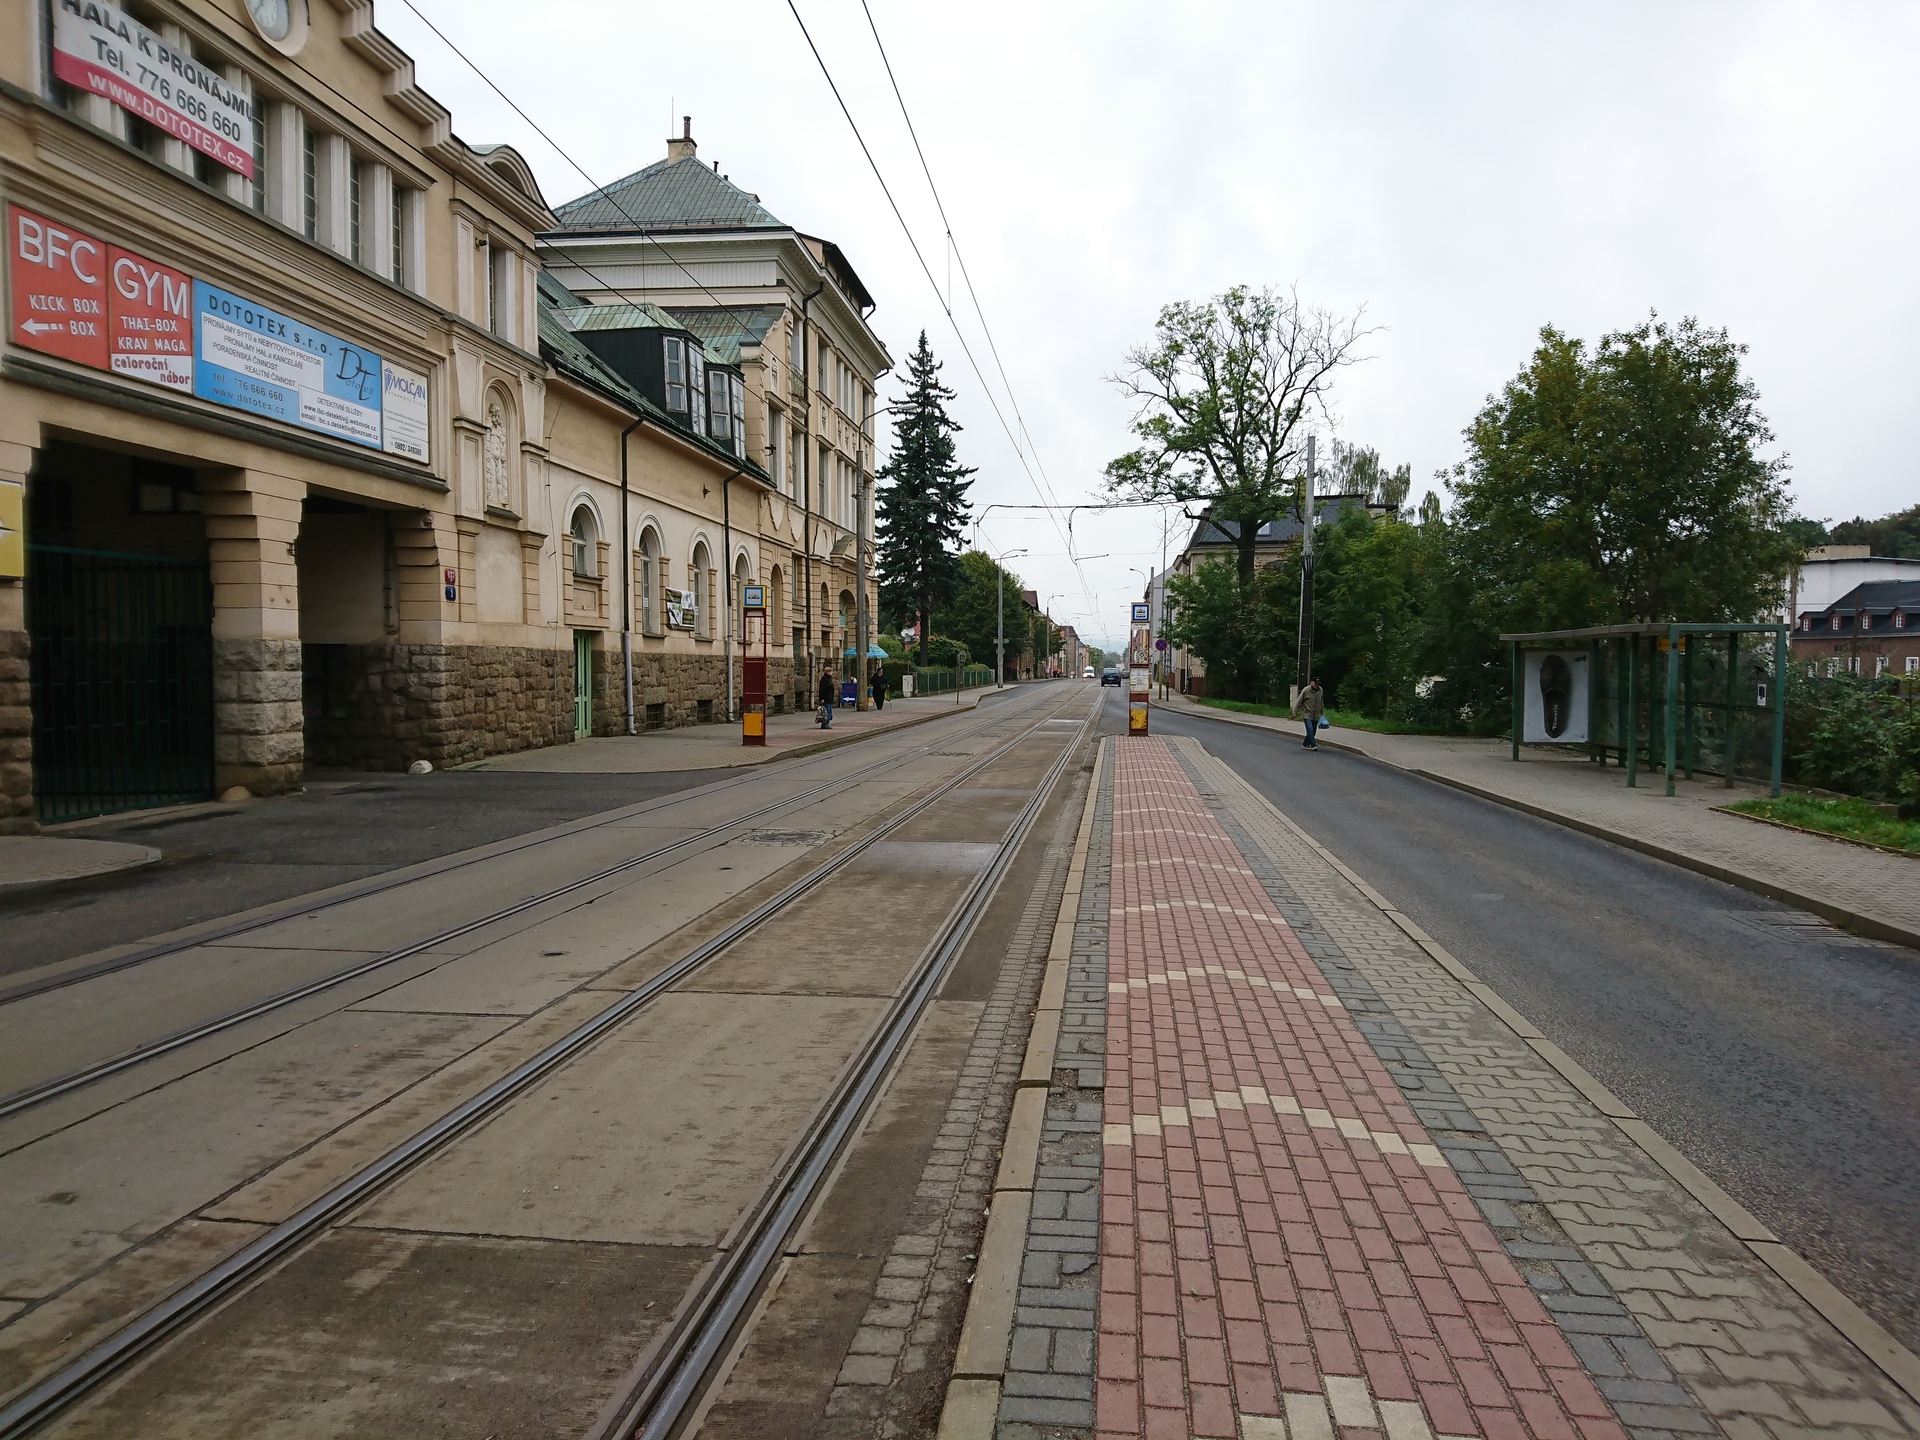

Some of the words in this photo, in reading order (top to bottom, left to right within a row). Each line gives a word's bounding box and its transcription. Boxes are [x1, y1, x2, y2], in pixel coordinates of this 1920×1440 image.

[61, 0, 131, 44] HALA
[137, 31, 153, 58] K
[158, 45, 252, 122] PRONÁJMU
[90, 34, 130, 75] Tel.
[136, 62, 170, 100] 776
[176, 88, 207, 122] 666
[212, 110, 241, 142] 660
[87, 71, 244, 170] www.DOTOTEX.cz
[18, 214, 96, 284] BFC
[113, 257, 188, 319] GYM
[29, 294, 66, 312] KICK
[73, 298, 100, 314] BOX
[69, 320, 96, 336] BOX
[120, 315, 178, 332] THAI-BOX
[209, 294, 286, 338] DOTOTEX
[293, 332, 332, 356] s.r.o.
[118, 336, 149, 350] KRAV
[154, 337, 187, 352] MAGA
[203, 316, 237, 335] PRONÁJMY
[257, 337, 296, 357] NEBYTOVÝCH
[223, 334, 255, 353] PRONÁJMY
[255, 347, 269, 358] HAL
[113, 356, 169, 371] celoroční
[212, 341, 252, 362] PORADENSKÁ
[252, 355, 279, 372] ČINNOST
[160, 371, 191, 385] nábor
[244, 364, 271, 380] REALITNÍ
[270, 371, 296, 388] ČINNOST
[233, 378, 249, 391] 776
[250, 383, 266, 398] 666
[267, 391, 283, 403] 660
